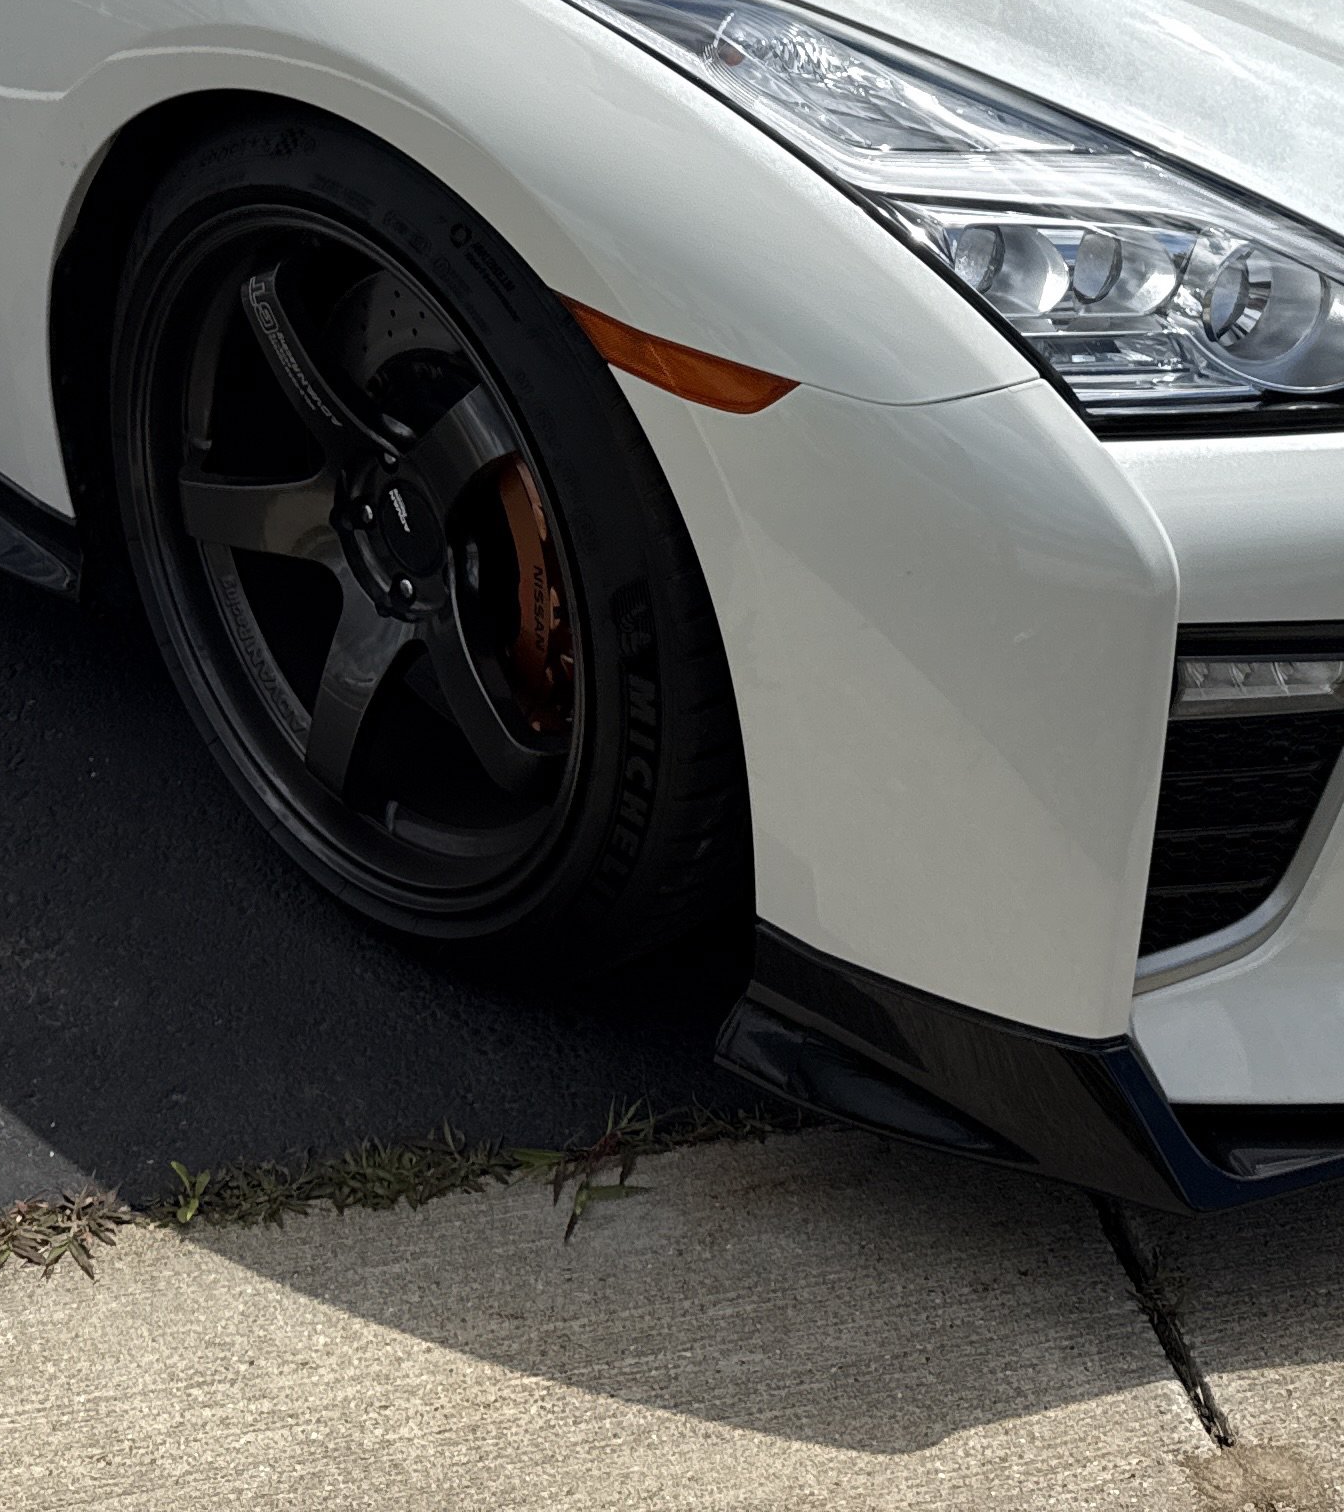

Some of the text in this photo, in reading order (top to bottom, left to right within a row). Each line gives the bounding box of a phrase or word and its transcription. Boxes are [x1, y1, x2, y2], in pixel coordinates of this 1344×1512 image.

[533, 566, 547, 651] NISSAN
[244, 642, 306, 733] ADVAN
[577, 671, 657, 912] MICHELI
